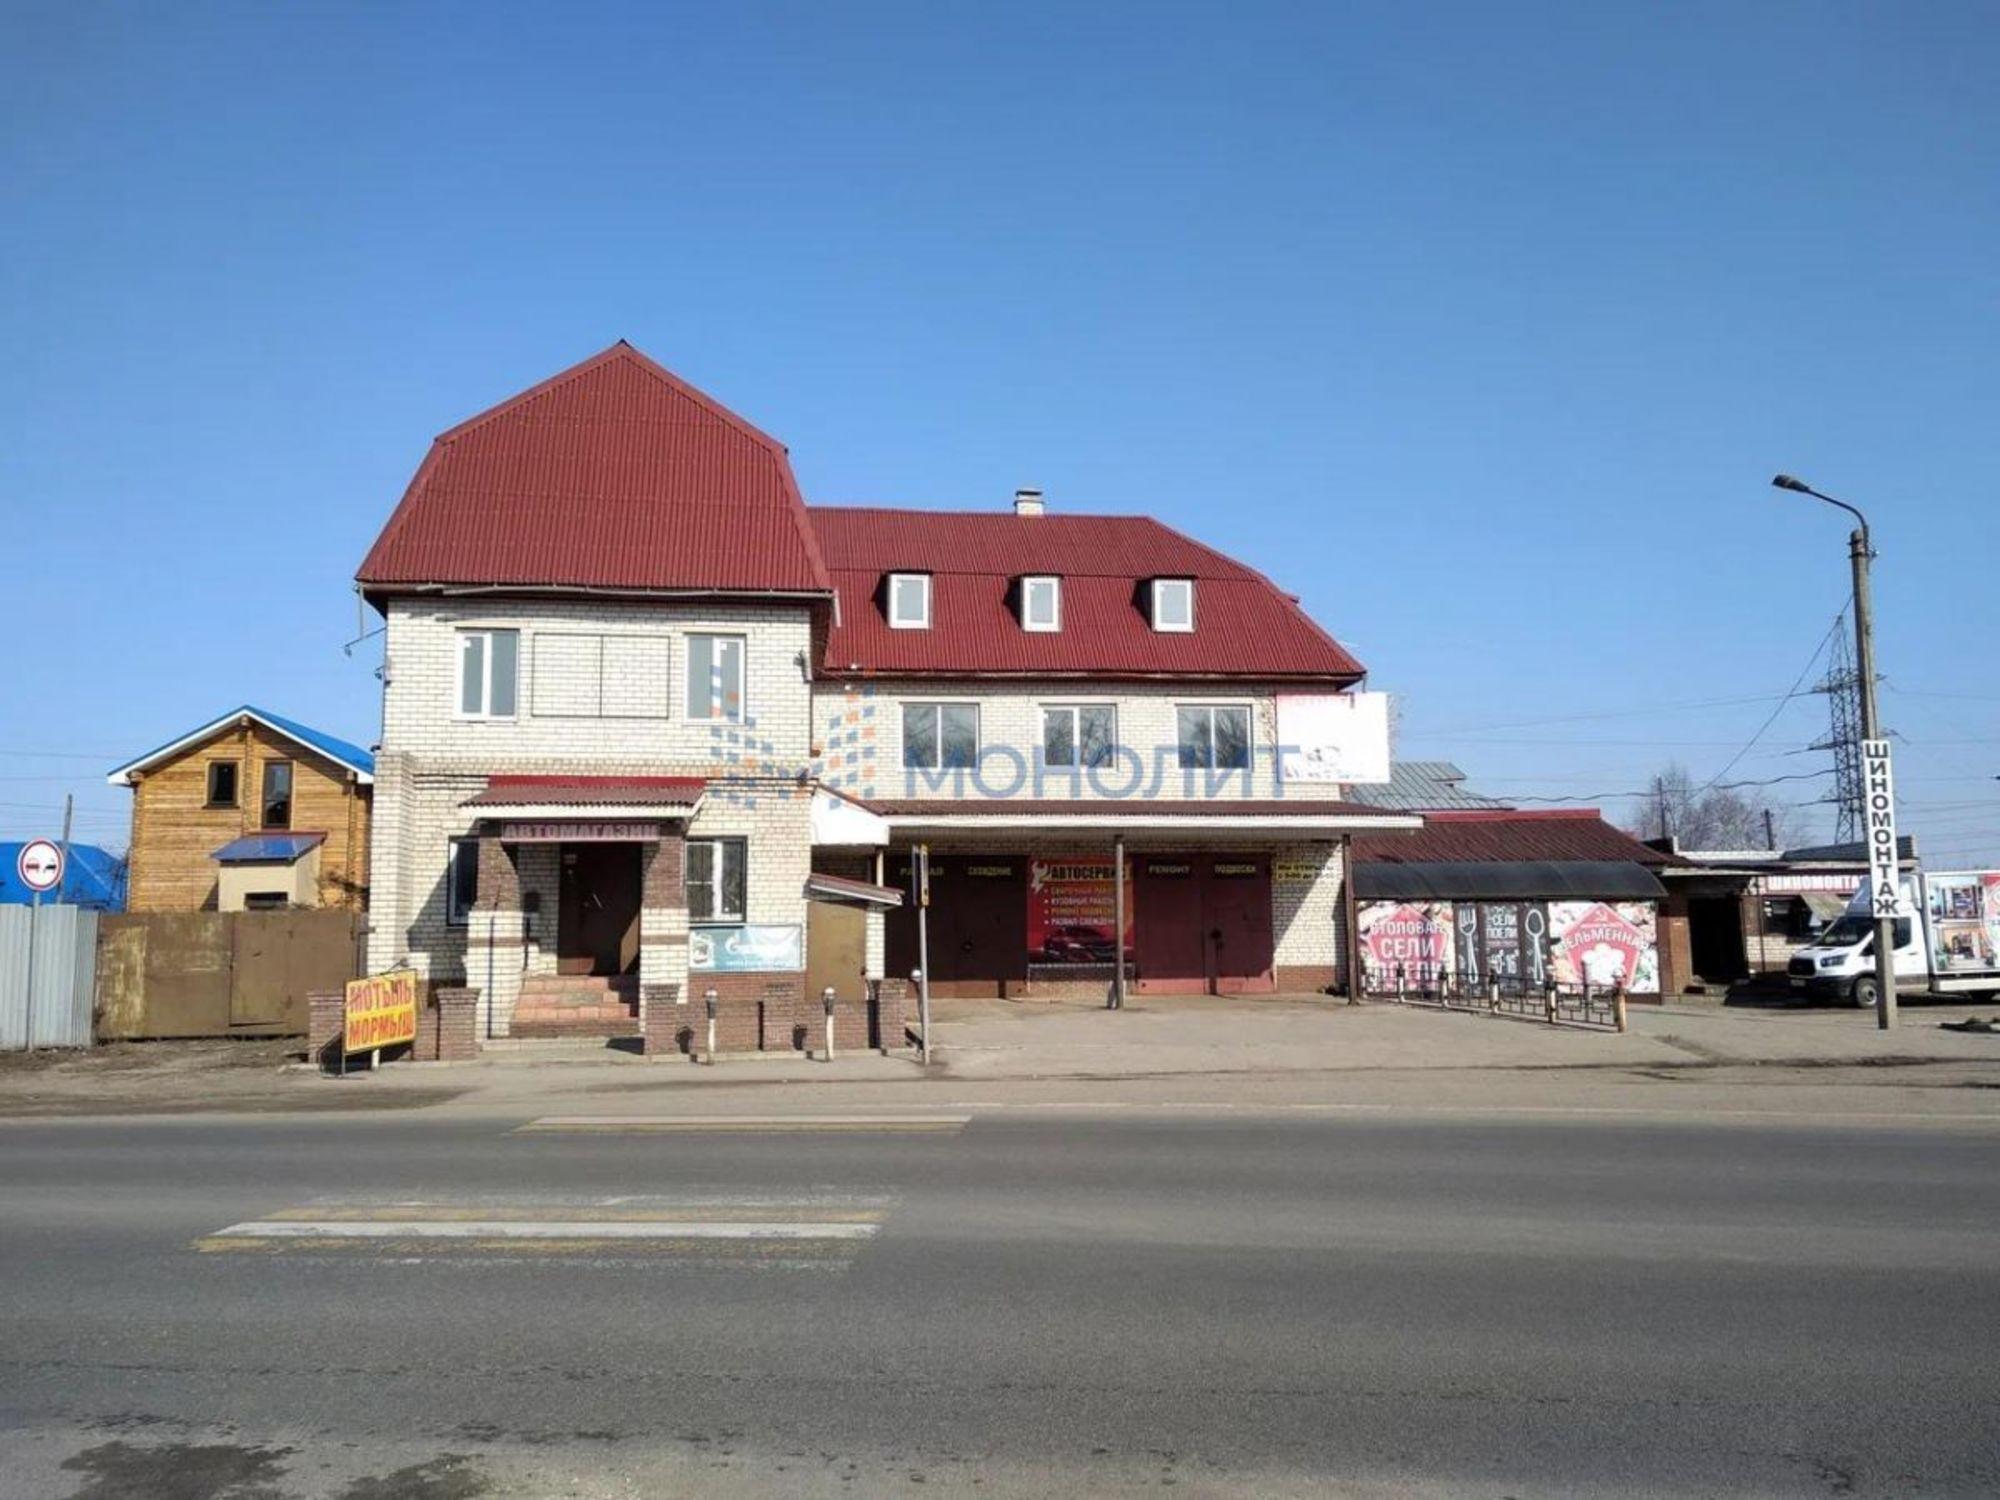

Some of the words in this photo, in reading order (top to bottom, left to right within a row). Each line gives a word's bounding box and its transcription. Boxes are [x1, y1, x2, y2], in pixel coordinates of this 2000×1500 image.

[503, 823, 659, 839] АВТОМАГАЗИН
[1865, 743, 1899, 914] ШИНОМОНТАЖ
[900, 867, 944, 876] РААЛ
[1380, 938, 1435, 959] СЕЛИ
[349, 979, 412, 1013] МОТЫЛЬ
[348, 1011, 413, 1049] МОРМЫШ
